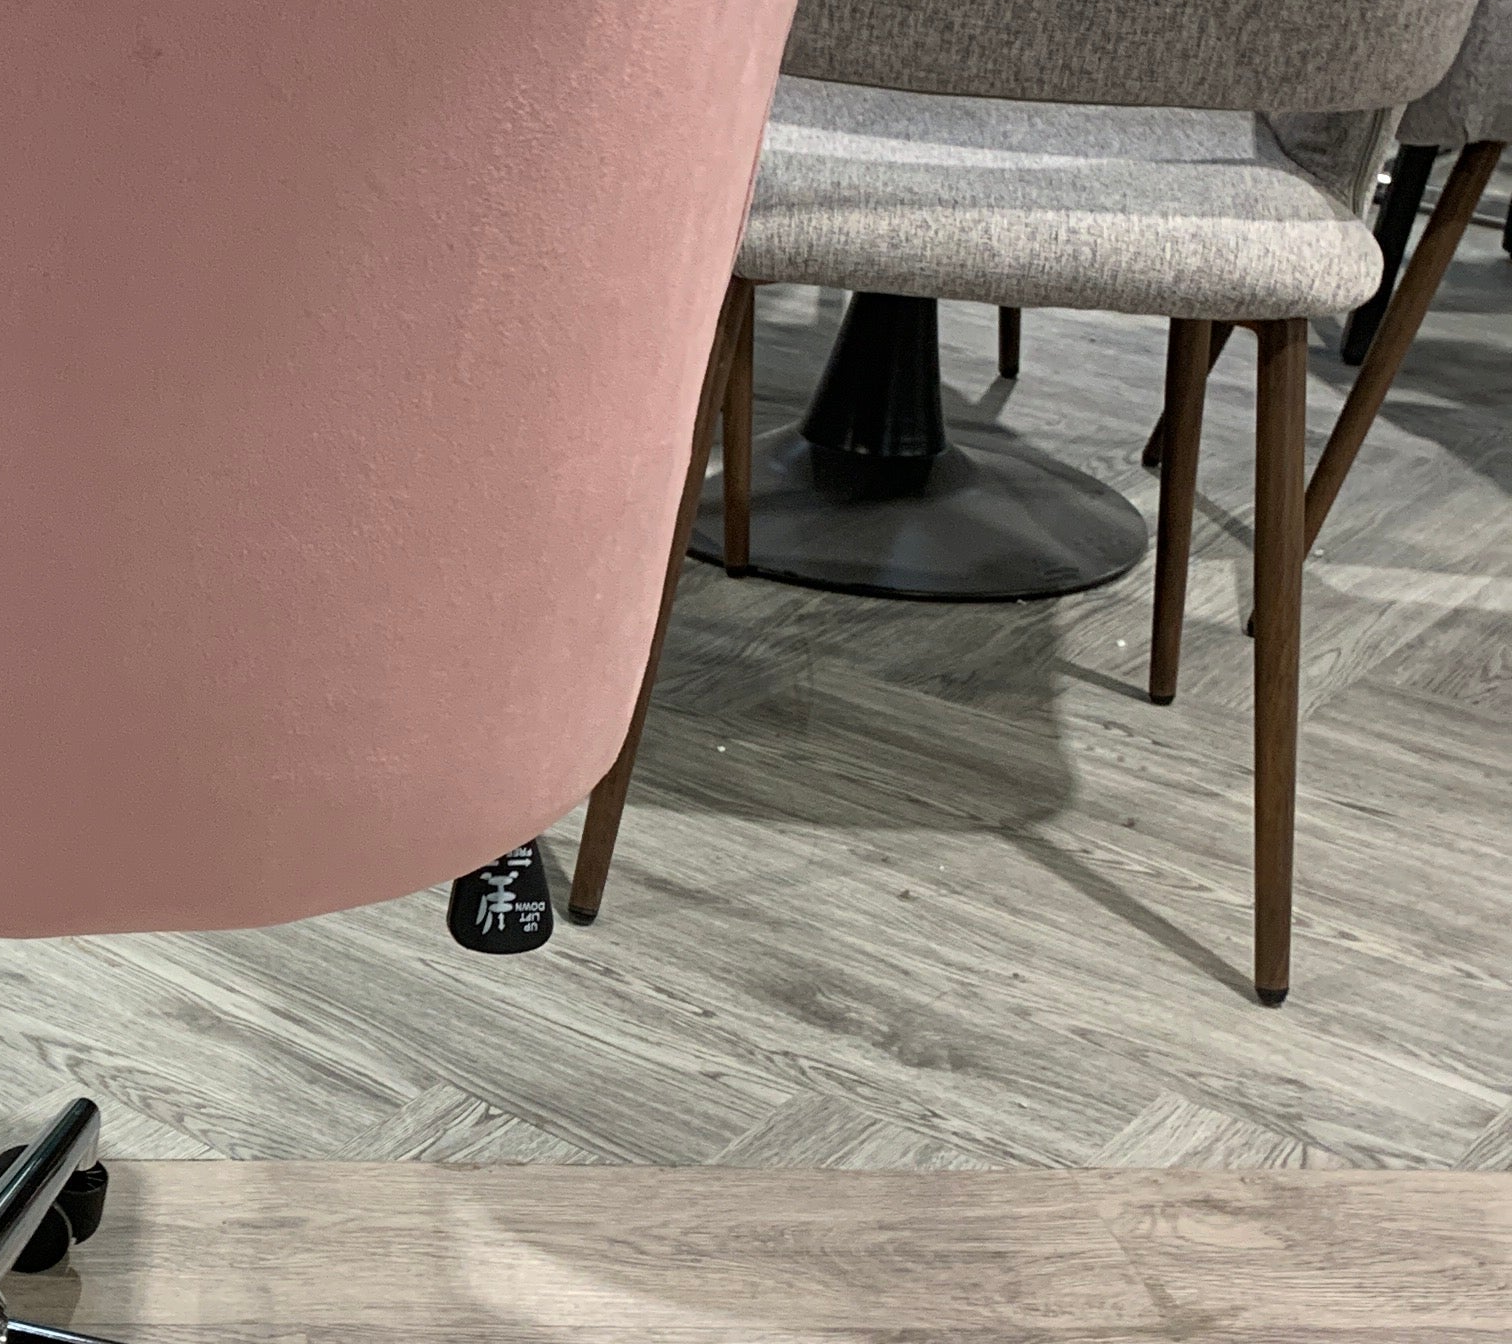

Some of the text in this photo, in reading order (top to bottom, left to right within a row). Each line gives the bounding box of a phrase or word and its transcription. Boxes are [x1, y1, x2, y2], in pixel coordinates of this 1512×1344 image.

[515, 901, 546, 912] DOWN
[519, 912, 541, 923] LIFT
[523, 922, 538, 933] UP
